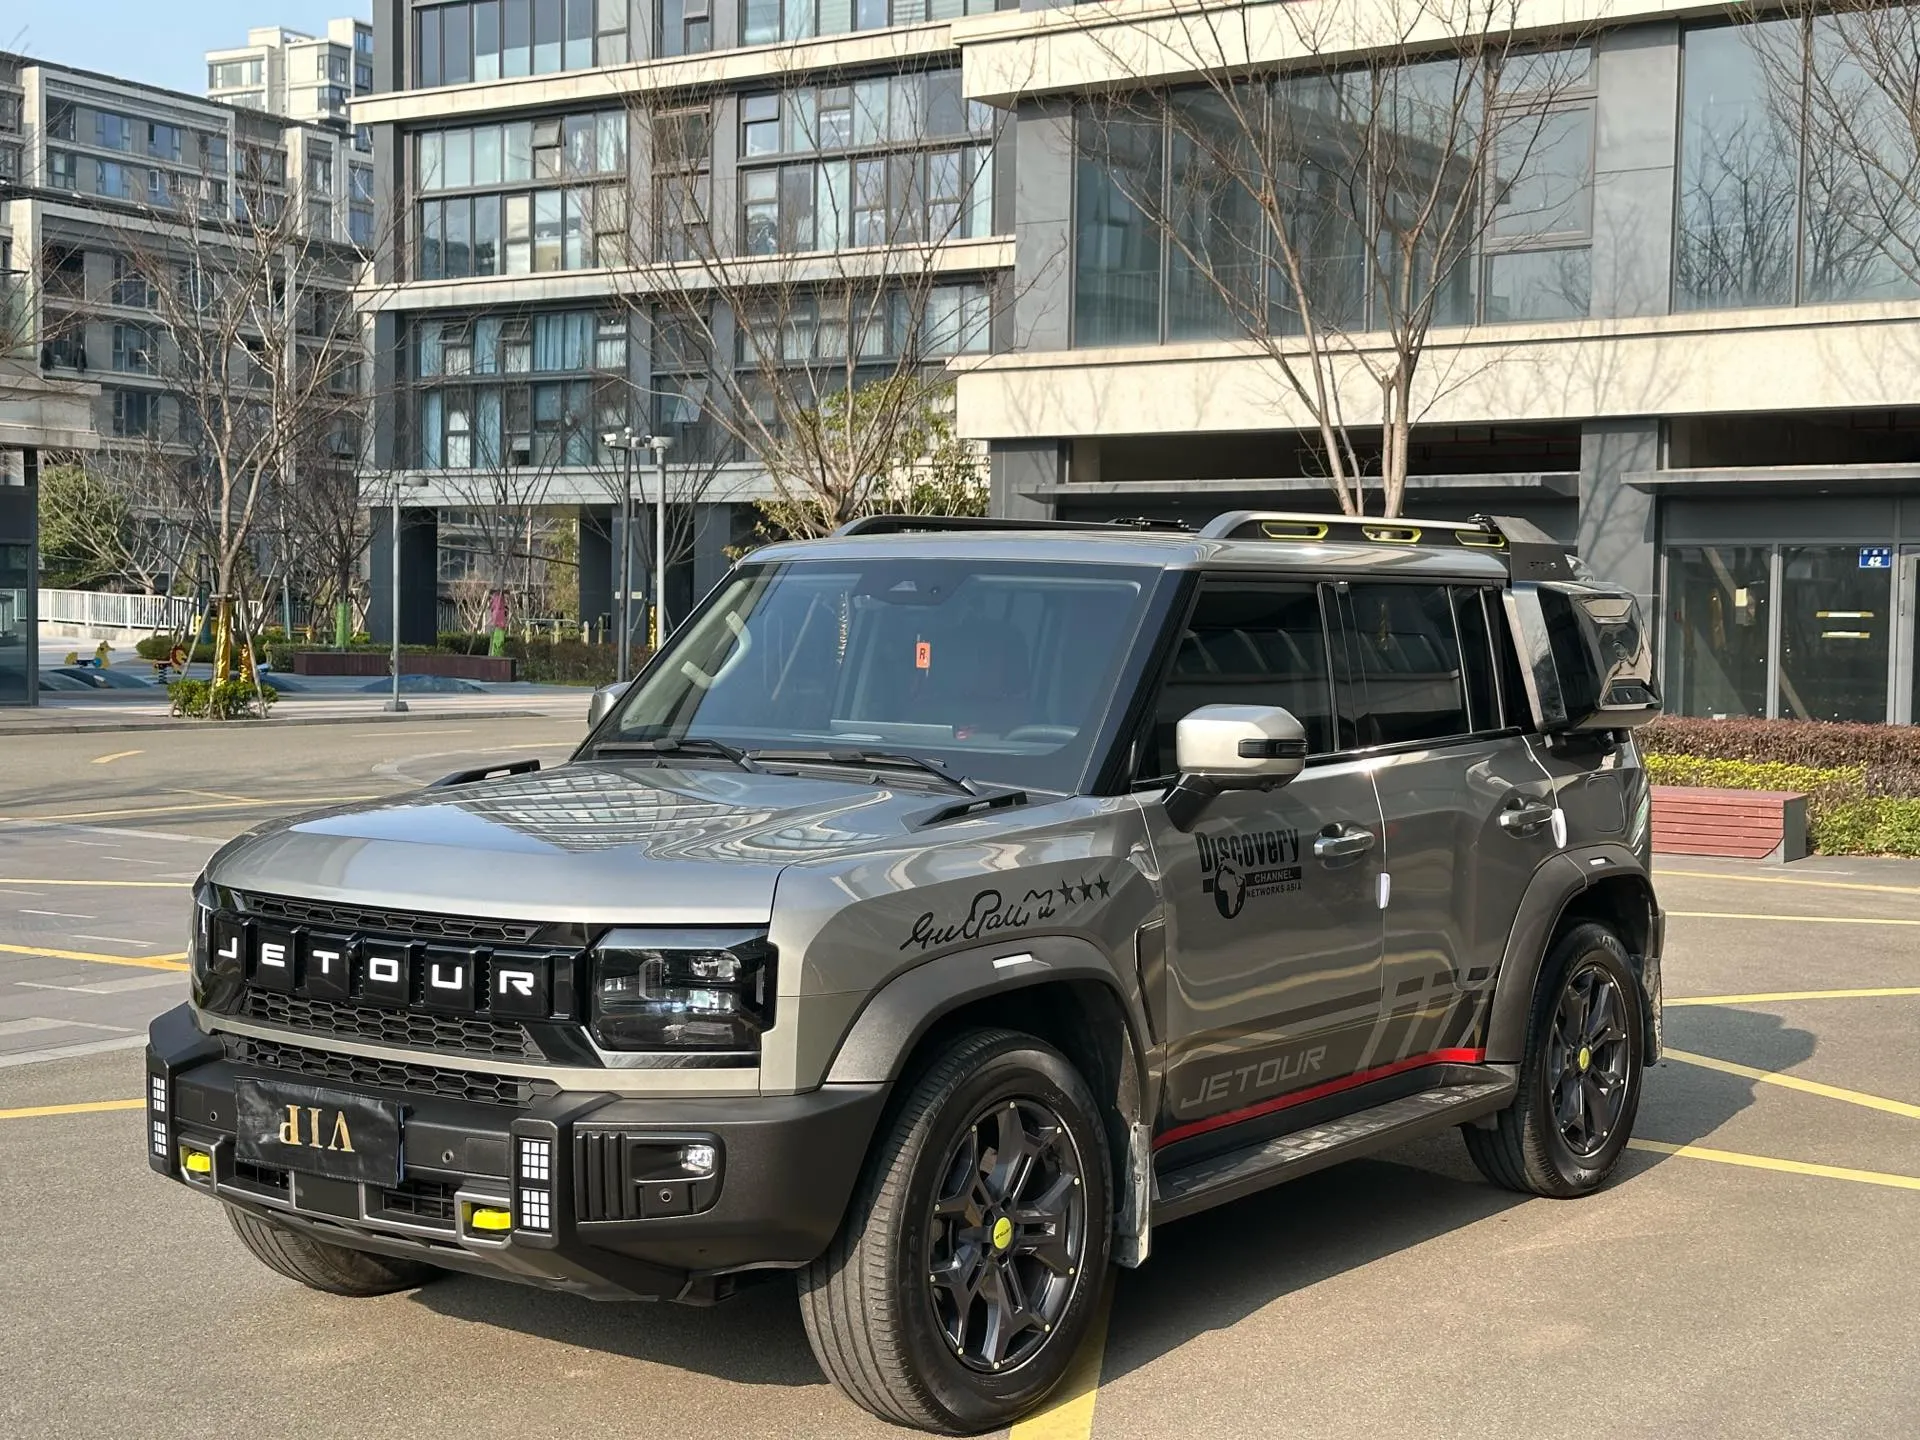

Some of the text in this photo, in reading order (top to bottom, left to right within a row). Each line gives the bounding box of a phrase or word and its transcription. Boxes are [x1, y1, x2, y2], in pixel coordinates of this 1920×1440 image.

[1867, 556, 1882, 567] 42
[1254, 869, 1294, 884] CHANNEL
[218, 937, 534, 996] JETOUR
[1180, 1045, 1327, 1109] JETOUR
[278, 1104, 355, 1153] VIP
